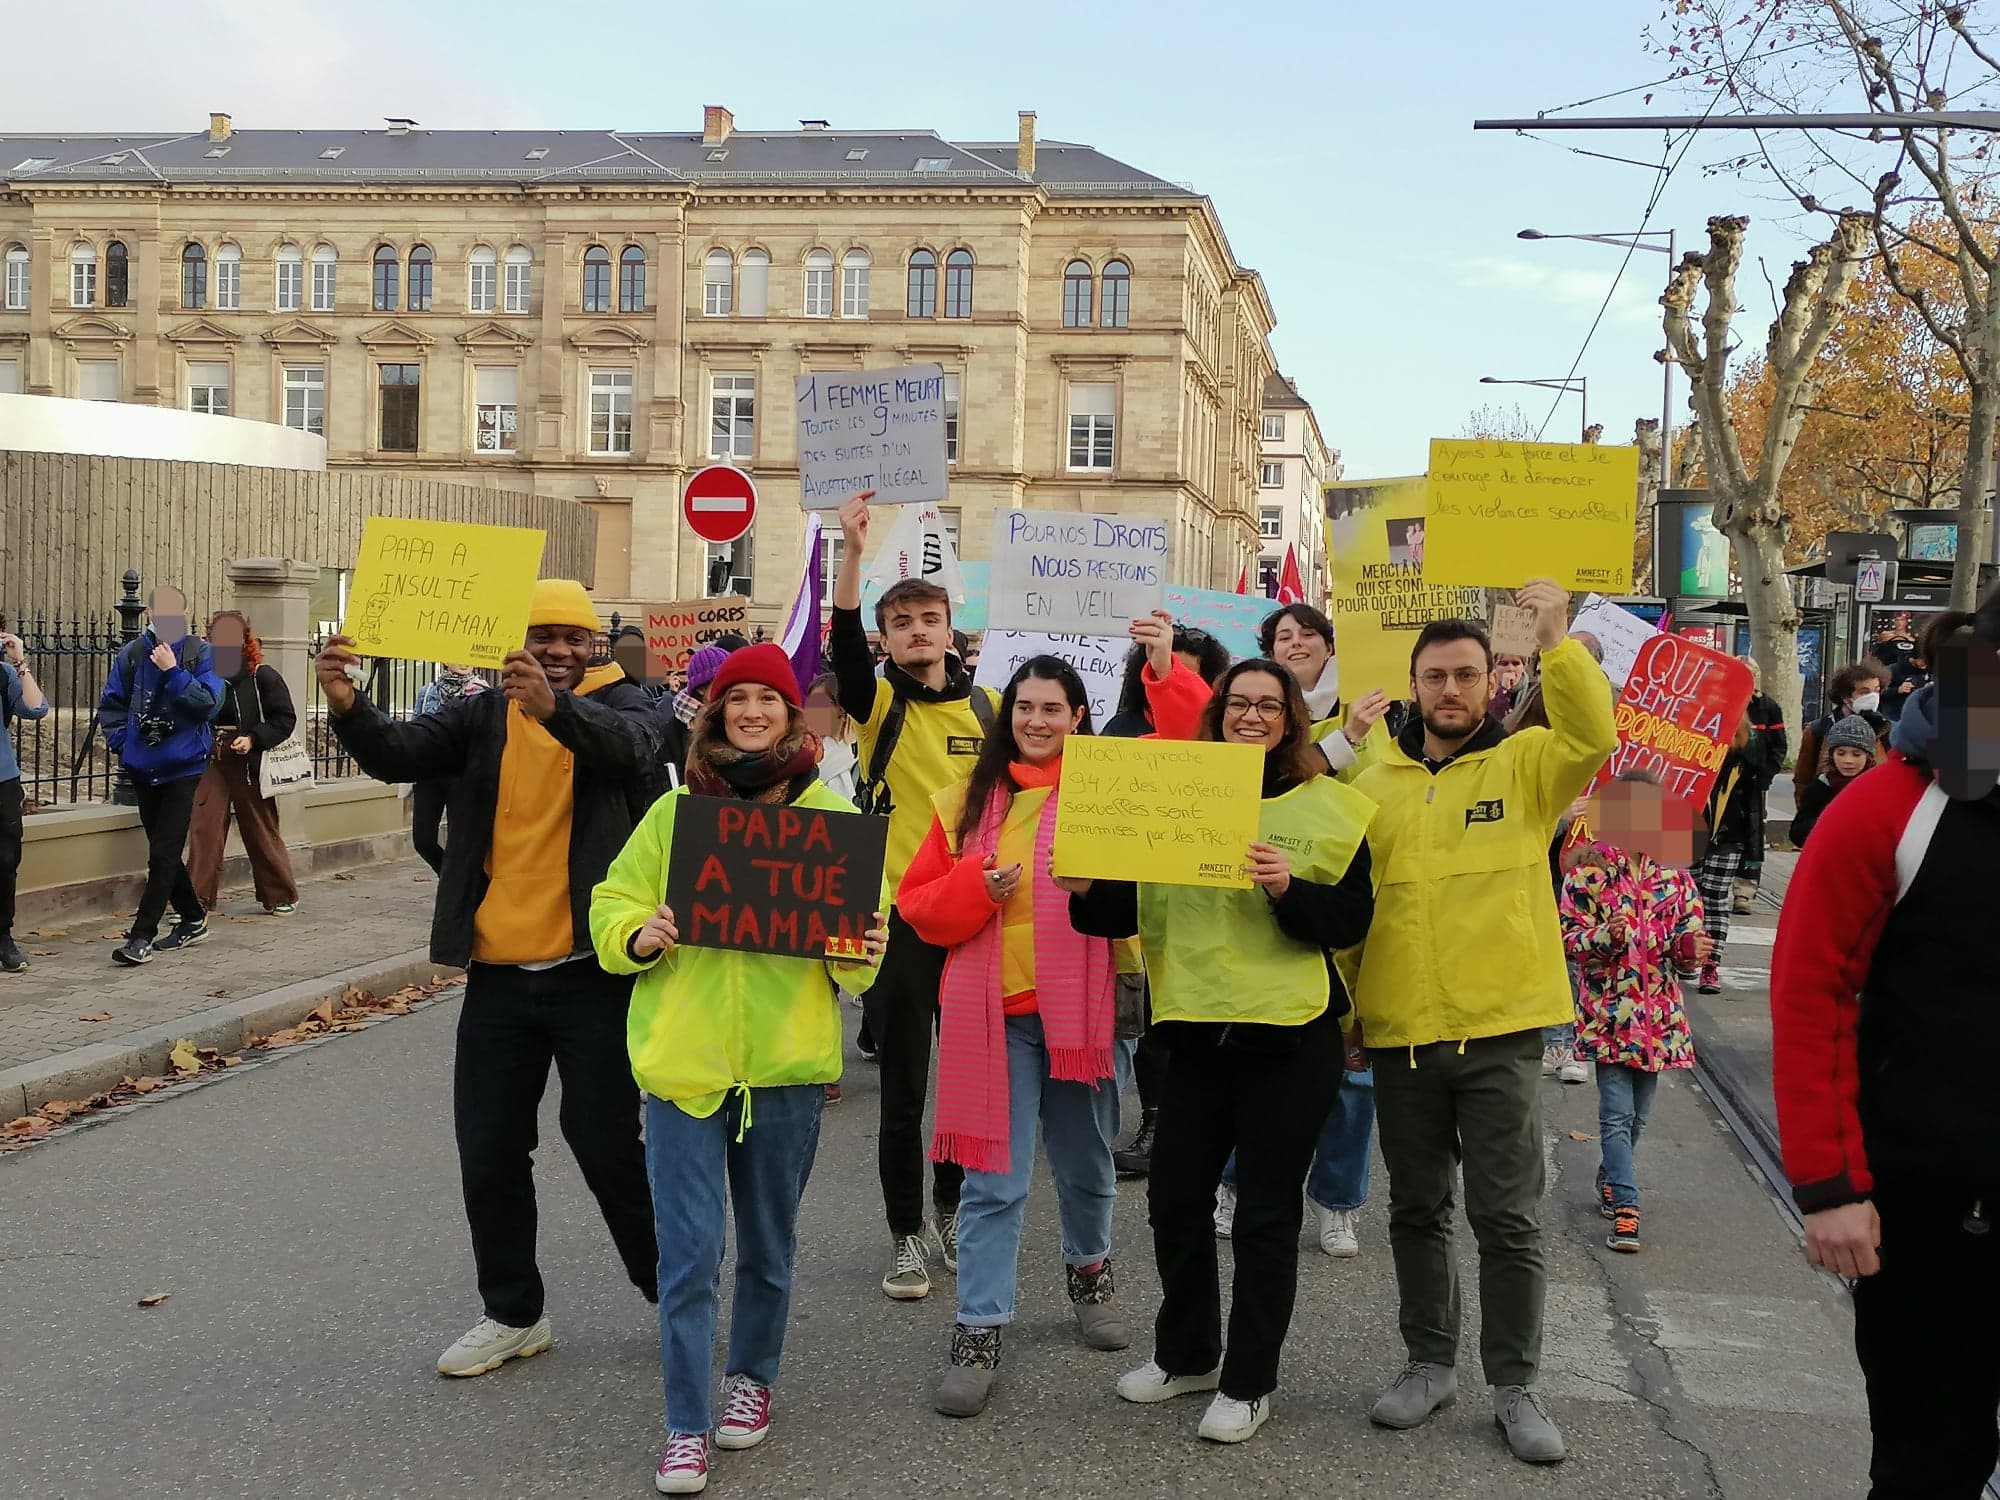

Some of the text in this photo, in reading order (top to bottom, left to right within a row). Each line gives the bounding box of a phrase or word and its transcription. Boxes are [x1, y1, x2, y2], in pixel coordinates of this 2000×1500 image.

[799, 376, 943, 413] 1 FEMME MEURT
[848, 416, 865, 430] LES
[871, 405, 888, 436] 9
[893, 409, 938, 424] MINUTES
[804, 442, 911, 464] DES SUITES D'UN
[1559, 447, 1577, 463] et
[804, 473, 874, 498] AVORTEMENT
[1500, 469, 1518, 484] de
[380, 535, 467, 566] PAPA A
[1032, 554, 1158, 586] NOUS RESTONS
[1362, 562, 1400, 579] MERCI
[1576, 568, 1610, 578] AMNESTY
[383, 573, 480, 600] INSULTÉ
[1356, 581, 1375, 597] QUI
[1378, 580, 1392, 594] SE
[1027, 590, 1128, 618] EN VEIL
[1337, 596, 1368, 613] POUR
[1410, 592, 1428, 609] AIT
[1431, 592, 1444, 607] LE
[1446, 589, 1481, 605] CHOIX
[649, 607, 745, 628] MON CORPS
[1381, 611, 1395, 625] DE
[1456, 605, 1481, 621] PAS
[649, 634, 693, 649] MON
[1647, 638, 1713, 699] QUI
[1692, 706, 1723, 739] LA
[719, 806, 832, 852] PAPA
[1268, 834, 1301, 847] AMNESTY
[695, 854, 848, 906] A TUÉ
[1199, 863, 1233, 873] AMNESTY
[691, 902, 866, 955] MAMAN
